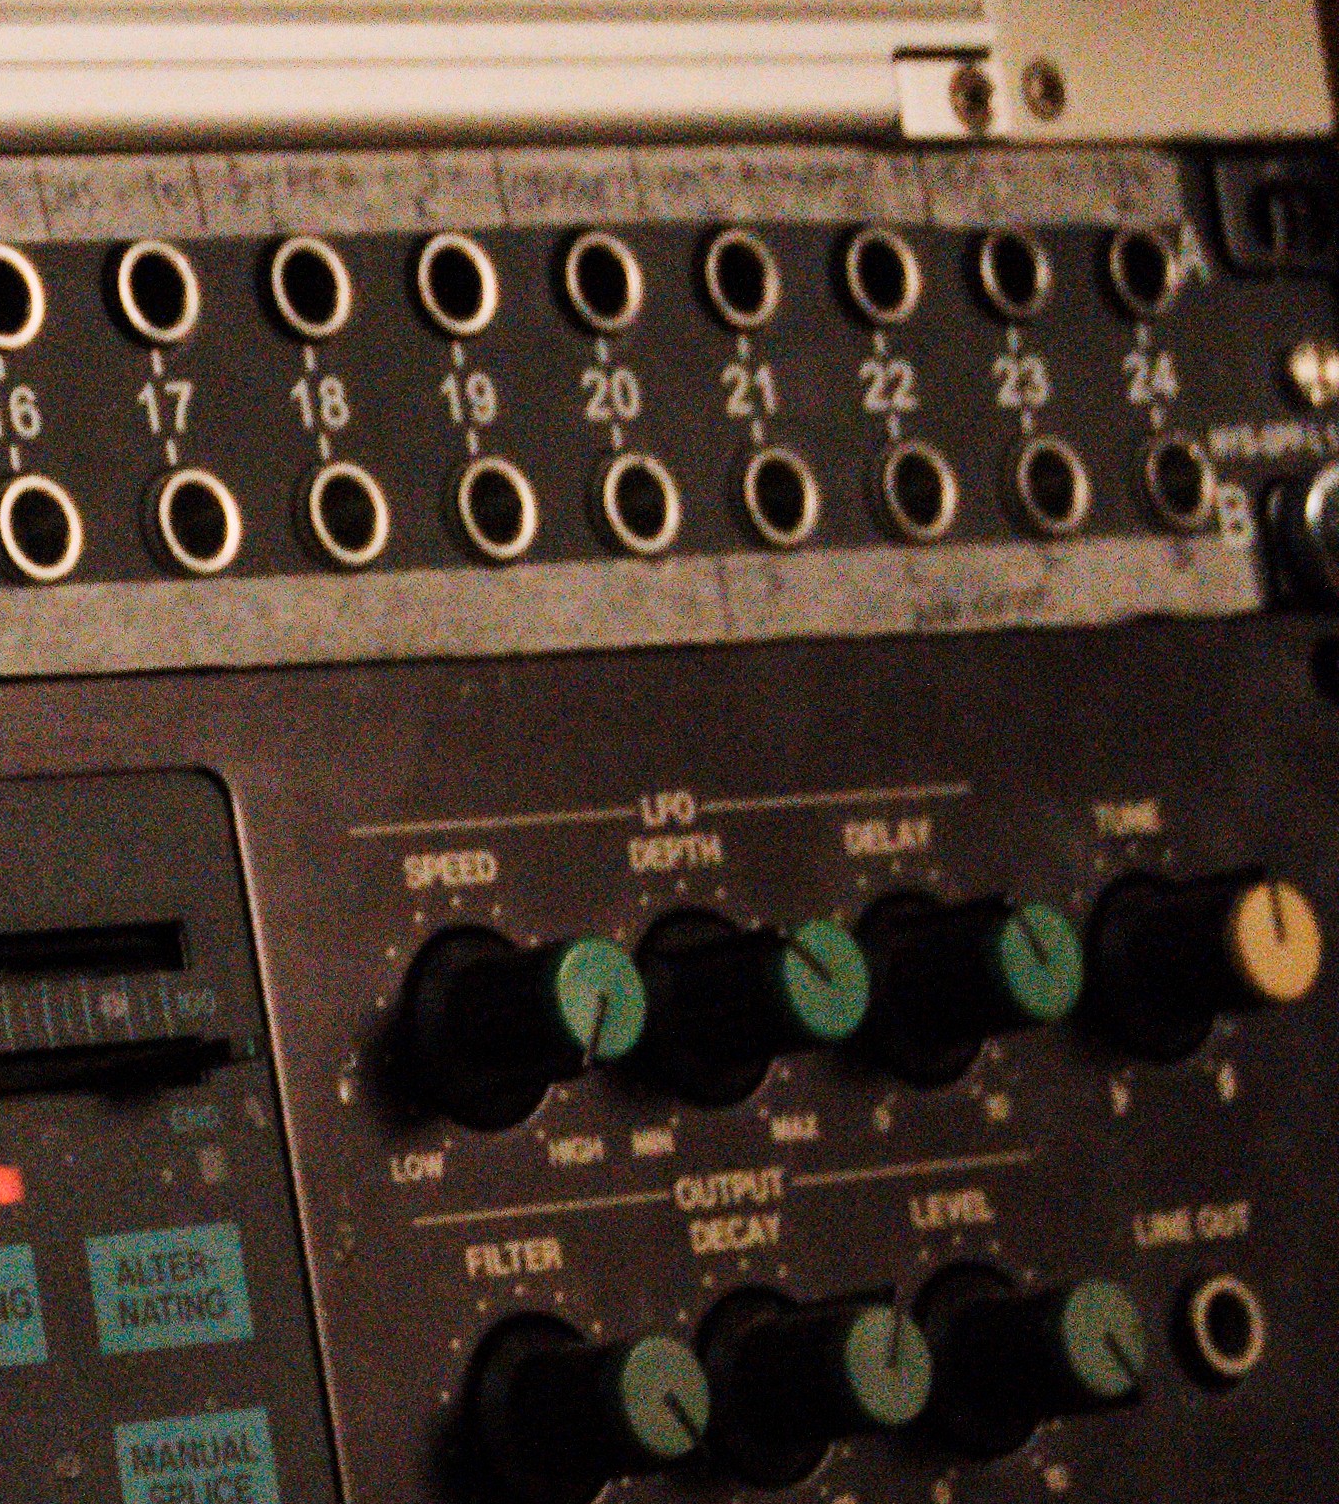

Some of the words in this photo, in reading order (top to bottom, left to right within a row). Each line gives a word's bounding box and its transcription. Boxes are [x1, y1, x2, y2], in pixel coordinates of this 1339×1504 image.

[137, 379, 193, 434] 17
[291, 375, 350, 430] 18
[440, 371, 498, 425] 19
[581, 367, 641, 422] 20
[722, 364, 778, 416] 21
[640, 790, 696, 827] LFO
[403, 851, 498, 890] SPEED
[674, 1168, 783, 1211] OUTPUT
[465, 1237, 563, 1277] FILTER
